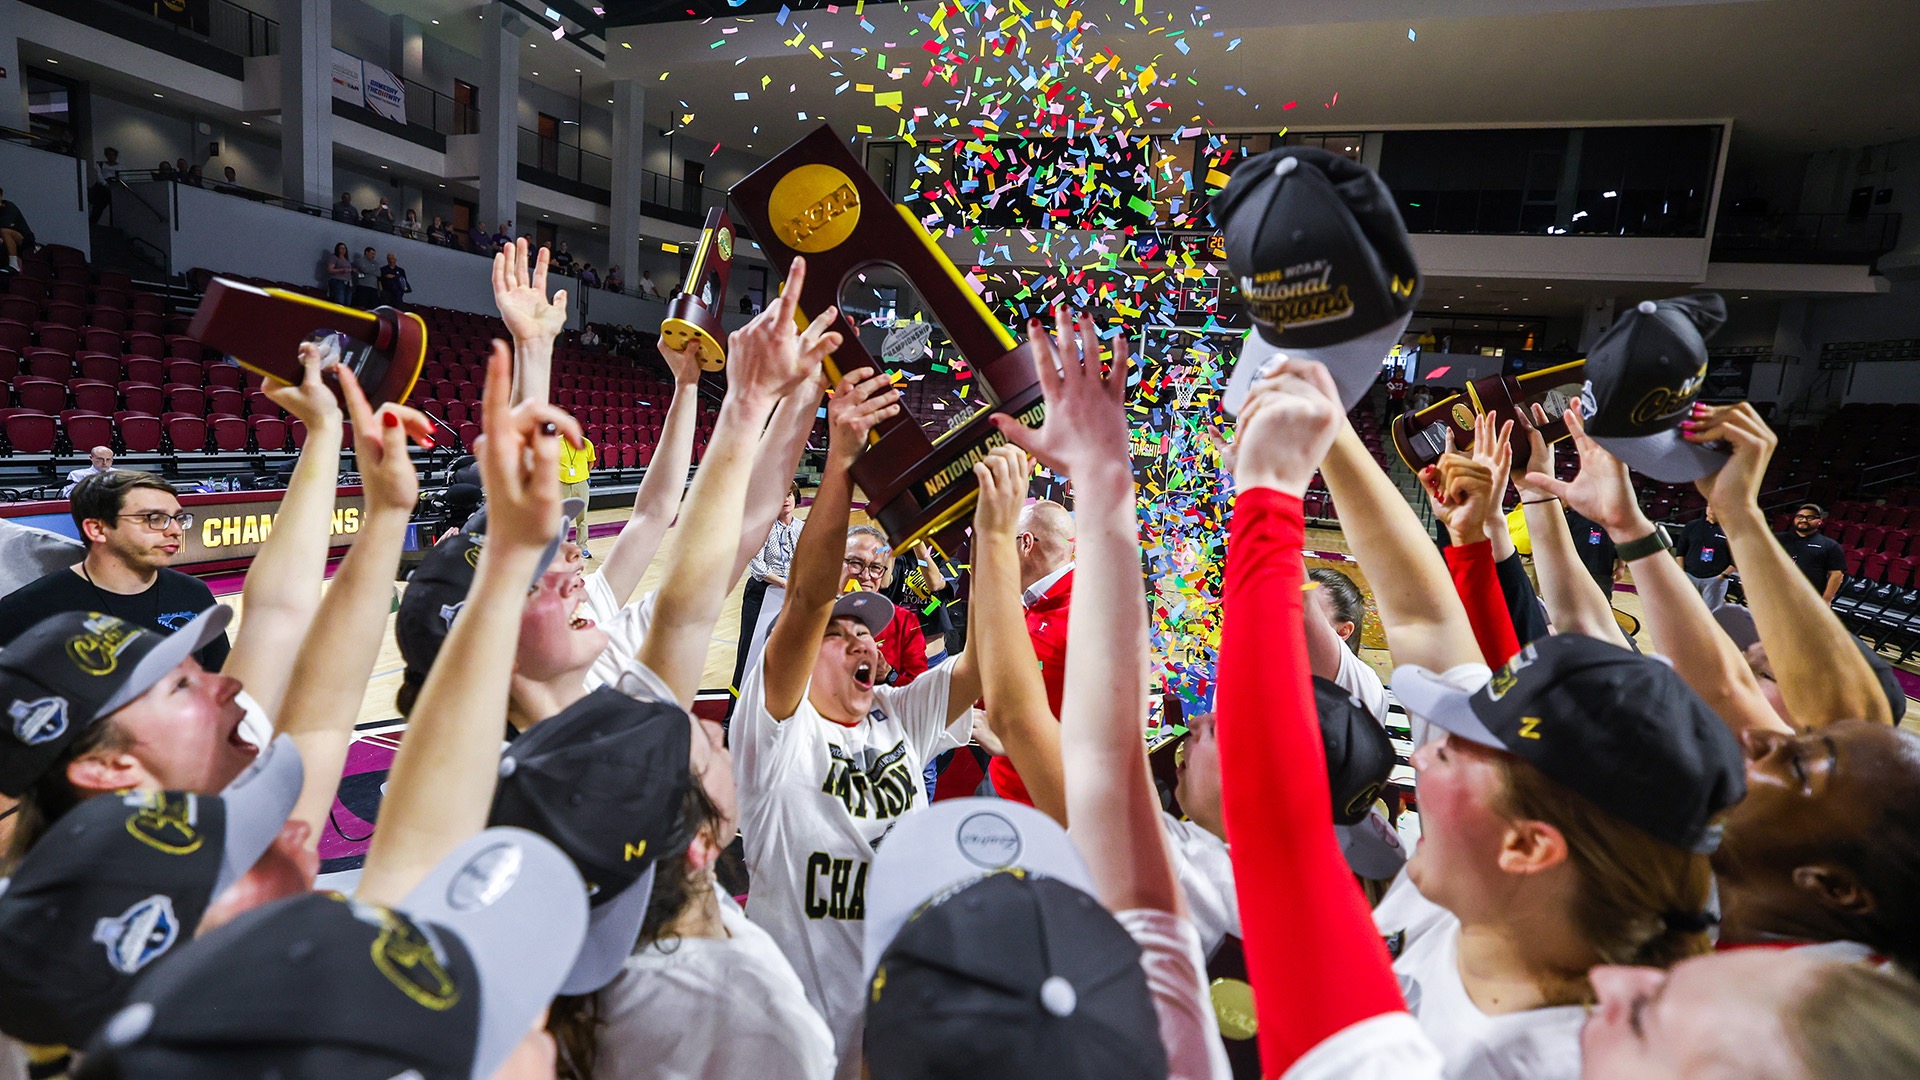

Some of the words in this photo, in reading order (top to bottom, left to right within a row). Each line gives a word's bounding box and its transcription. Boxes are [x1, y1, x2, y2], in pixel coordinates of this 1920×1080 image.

[781, 183, 859, 247] NCAA
[1210, 236, 1225, 249] 20
[1390, 274, 1415, 297] N
[924, 445, 987, 497] NATIONAL
[625, 840, 647, 861] N
